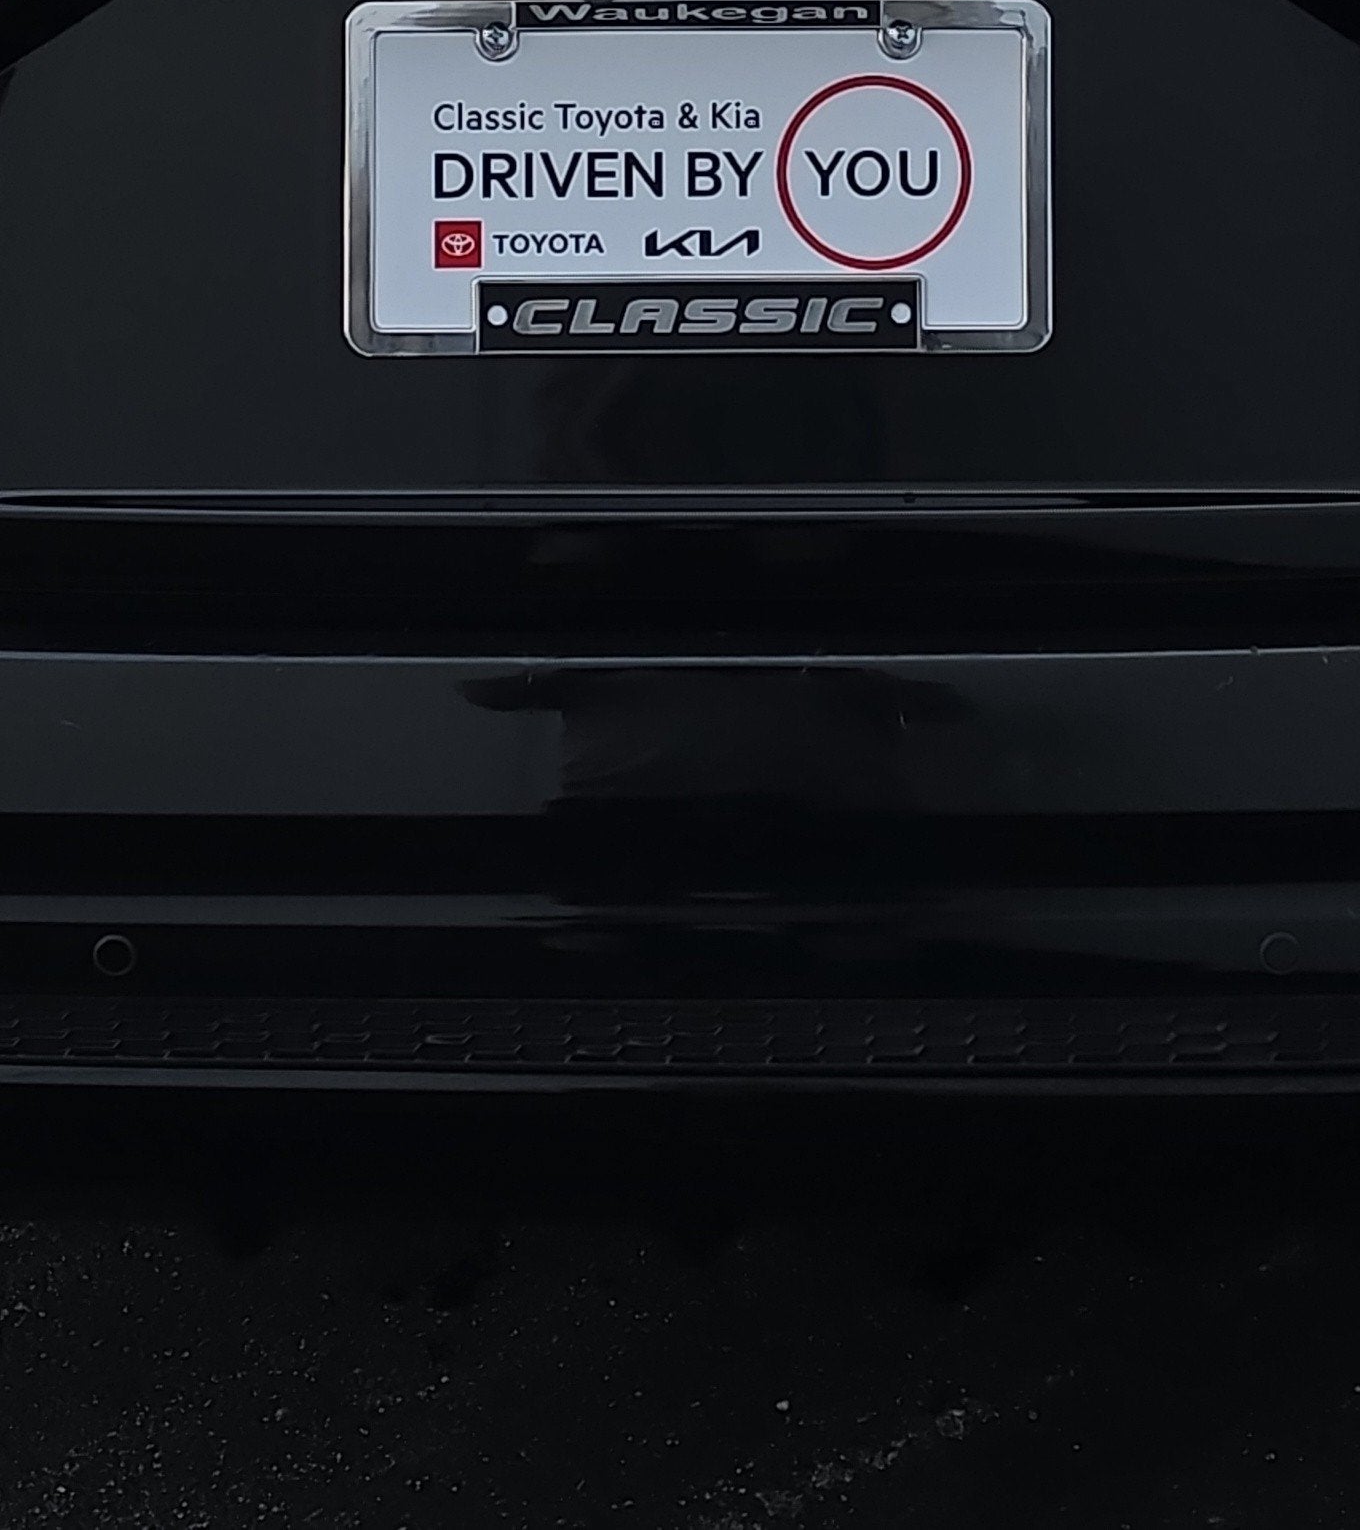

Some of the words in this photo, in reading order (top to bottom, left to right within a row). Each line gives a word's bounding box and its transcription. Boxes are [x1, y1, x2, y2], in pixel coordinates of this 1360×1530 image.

[529, 3, 869, 24] Waukegan
[434, 103, 544, 131] Classic
[554, 103, 665, 137] Toyota
[677, 104, 699, 130] &
[711, 103, 761, 130] Kia
[434, 151, 664, 199] DRIVEN
[687, 151, 764, 198] BY
[804, 149, 939, 197] YOU
[492, 233, 605, 255] TOYOTA
[512, 297, 886, 336] CLASSIC
